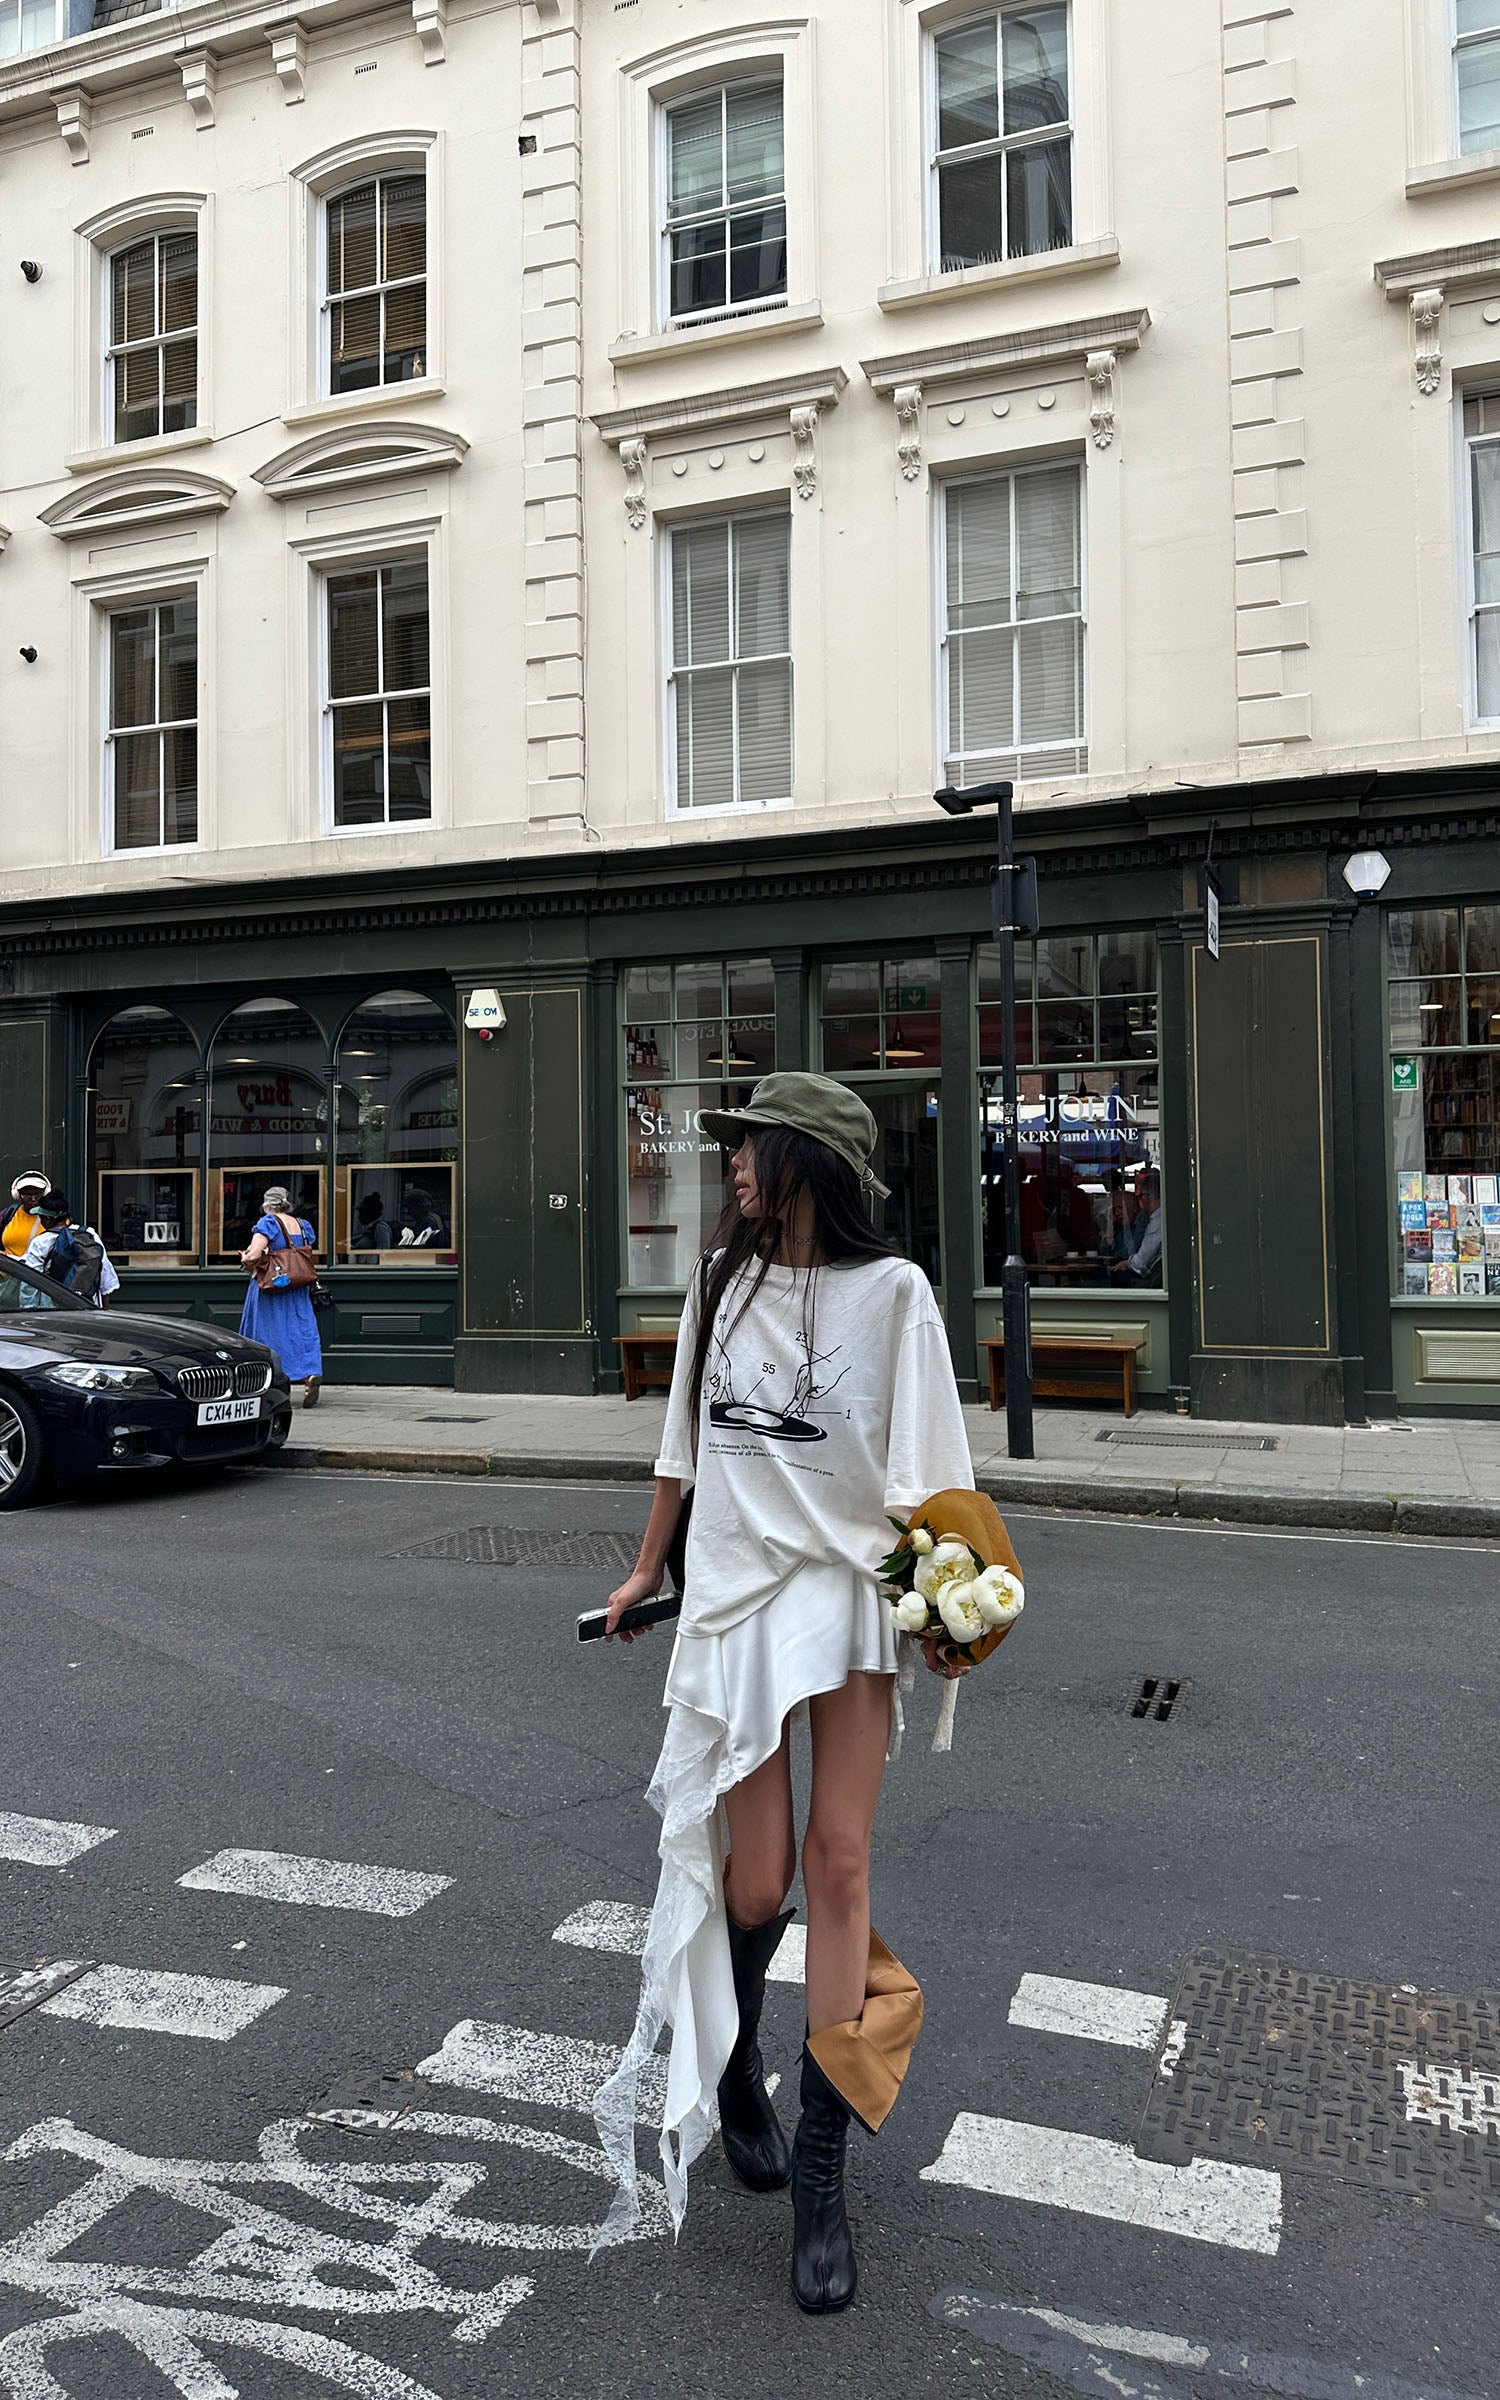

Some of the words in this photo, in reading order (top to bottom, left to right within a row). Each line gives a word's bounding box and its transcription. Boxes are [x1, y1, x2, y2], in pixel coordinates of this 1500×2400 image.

[469, 1008, 497, 1017] SEOM
[1044, 1095, 1140, 1124] JOHN
[640, 1111, 672, 1136] St.
[681, 1108, 746, 1135] JO
[995, 1129, 1060, 1144] BKERY
[1063, 1130, 1089, 1142] and
[1094, 1127, 1139, 1141] WINE
[640, 1142, 697, 1154] BAKERY
[698, 1142, 720, 1152] and
[795, 1331, 808, 1342] 23
[762, 1362, 776, 1374] 55
[206, 1404, 232, 1421] CX14
[234, 1401, 254, 1418] HVE
[845, 1409, 851, 1419] 1
